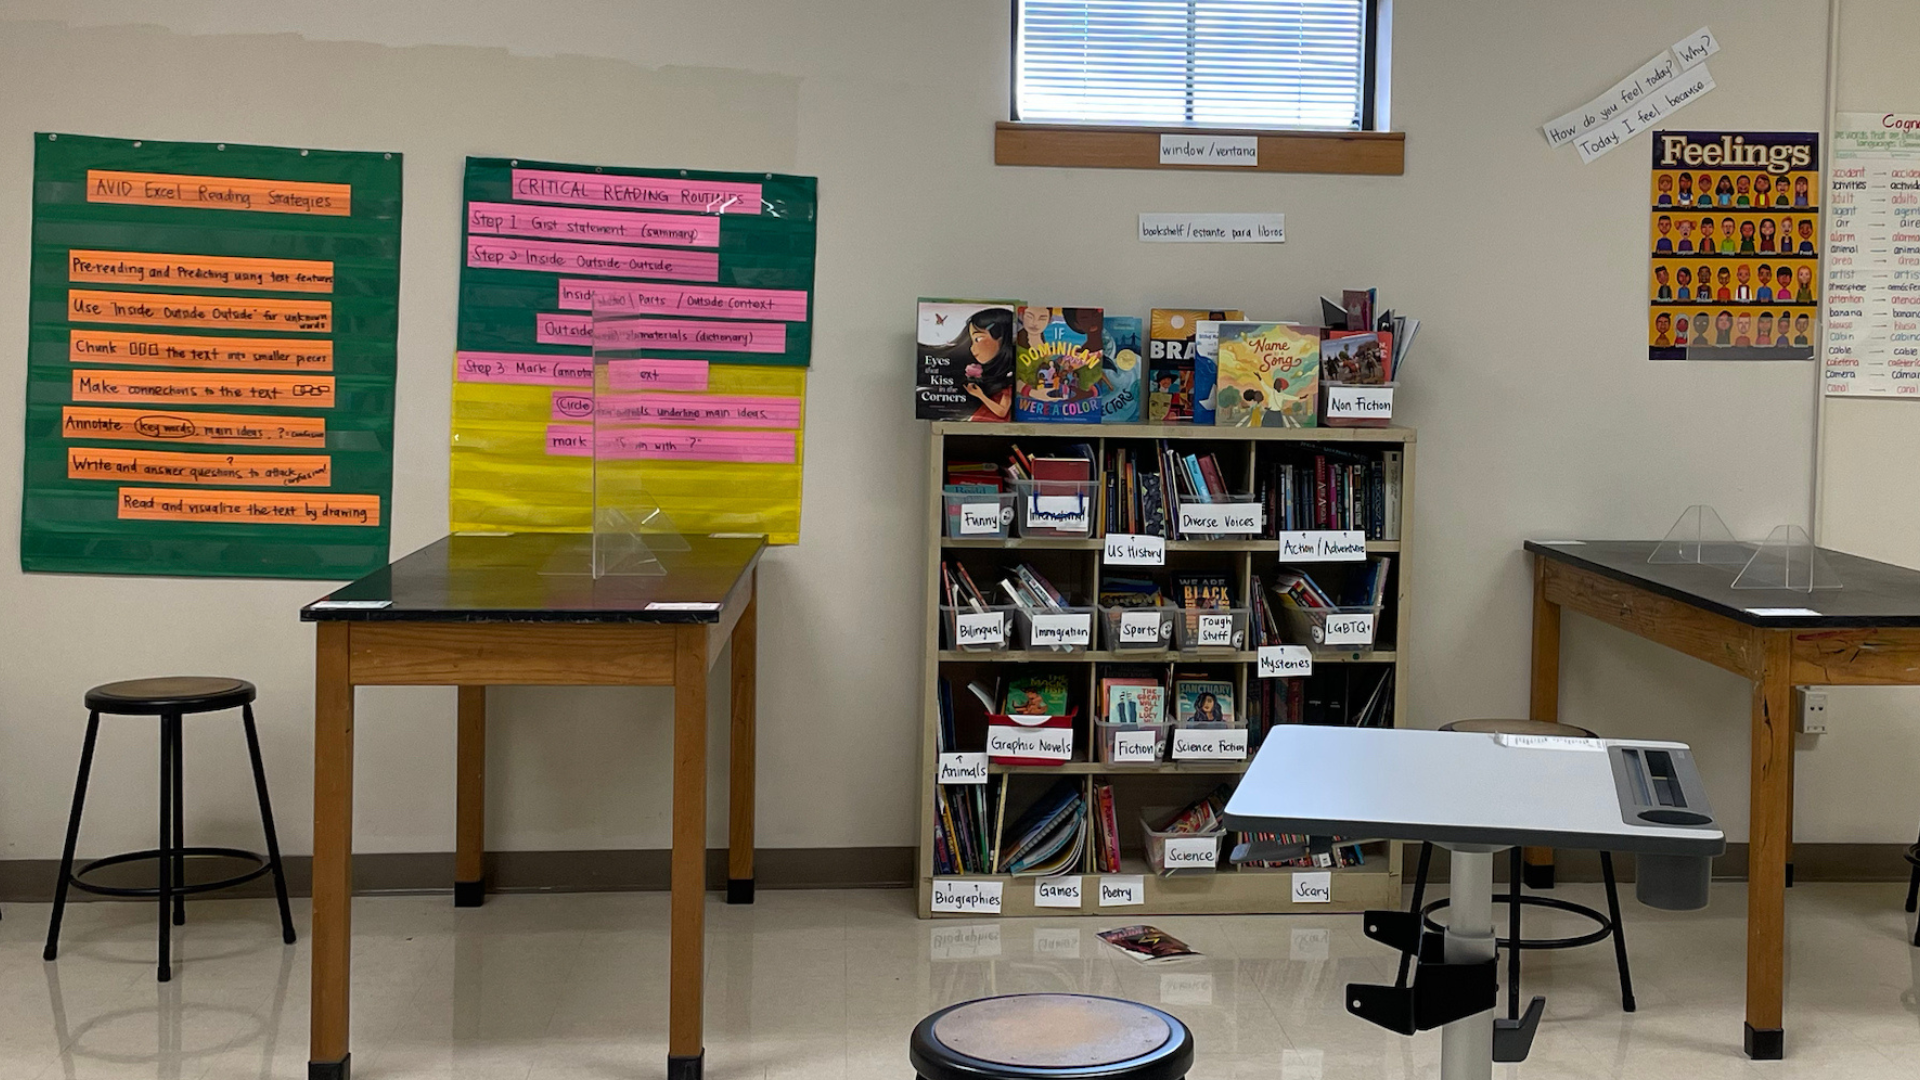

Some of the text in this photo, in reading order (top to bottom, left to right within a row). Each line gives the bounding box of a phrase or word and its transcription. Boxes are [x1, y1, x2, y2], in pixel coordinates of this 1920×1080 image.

[1680, 36, 1711, 62] Why?
[1550, 60, 1673, 143] How do you feel today?
[1621, 119, 1635, 133] I
[1162, 141, 1205, 156] window
[1661, 135, 1810, 175] Feelings
[97, 180, 331, 212] AVID Excel Reading Strategies
[518, 177, 589, 198] CRITICAL
[604, 184, 669, 202] READING
[472, 210, 699, 243] Step 1 Gist statement (summary)
[1232, 224, 1283, 240] para libros
[472, 245, 504, 264] Step
[527, 249, 566, 266] Inside
[577, 253, 621, 269] Outside
[629, 258, 673, 272] Outside
[73, 258, 144, 280] Pre-reading
[150, 266, 170, 278] and
[178, 266, 228, 283] Predicting
[234, 272, 262, 284] using
[271, 273, 289, 283] text
[638, 294, 666, 306] Parts
[74, 300, 102, 315] Use
[164, 306, 206, 319] Outside
[263, 310, 278, 320] for
[284, 311, 328, 323] unknown
[299, 321, 325, 329] words
[545, 321, 593, 337] Outside
[1054, 327, 1065, 339] IF
[76, 339, 117, 354] Chunk
[166, 346, 185, 358] the
[191, 348, 219, 361] text
[253, 351, 290, 362] smaller
[296, 353, 327, 367] pieces
[1249, 338, 1290, 354] Name
[925, 355, 950, 367] Eyes
[1019, 341, 1100, 369] DOMINICAN
[1260, 353, 1302, 373] Song
[464, 361, 495, 377] Step
[516, 363, 547, 375] Mark
[80, 377, 283, 399] Make connections to the text
[930, 375, 954, 385] Kiss
[921, 391, 967, 402] Corners
[1332, 397, 1391, 412] Non Fiction
[559, 400, 591, 411] Circle
[657, 407, 699, 418] underline
[706, 408, 730, 418] main
[1019, 398, 1099, 416] WERE A COLOR
[65, 415, 123, 431] Annotate
[204, 424, 233, 437] main
[553, 436, 587, 447] mark
[655, 441, 677, 450] with
[73, 455, 297, 483] Write and answer questions to attack
[123, 495, 367, 523] Read and visualize the text by drawing
[965, 512, 997, 529] Funny
[1183, 515, 1255, 528] Diverse Voices
[1108, 542, 1163, 562] US History
[1284, 540, 1315, 554] Action
[960, 619, 1002, 638] Bilingual
[1203, 617, 1232, 628] Tough
[1035, 625, 1088, 641] Immigration
[1123, 625, 1157, 637] Sports
[1203, 630, 1228, 641] Stuff
[1261, 658, 1310, 673] Mysteries
[1180, 683, 1231, 697] SANCTUARY
[992, 736, 1071, 754] Graphic Novels
[1119, 741, 1153, 755] Fiction
[1175, 739, 1245, 753] Science Fiction
[942, 762, 986, 779] Animals
[1169, 848, 1215, 861] Science
[1040, 883, 1080, 898] Games
[1103, 885, 1132, 901] Poetry
[1296, 882, 1330, 900] Scary
[936, 890, 1000, 909] Biographies
